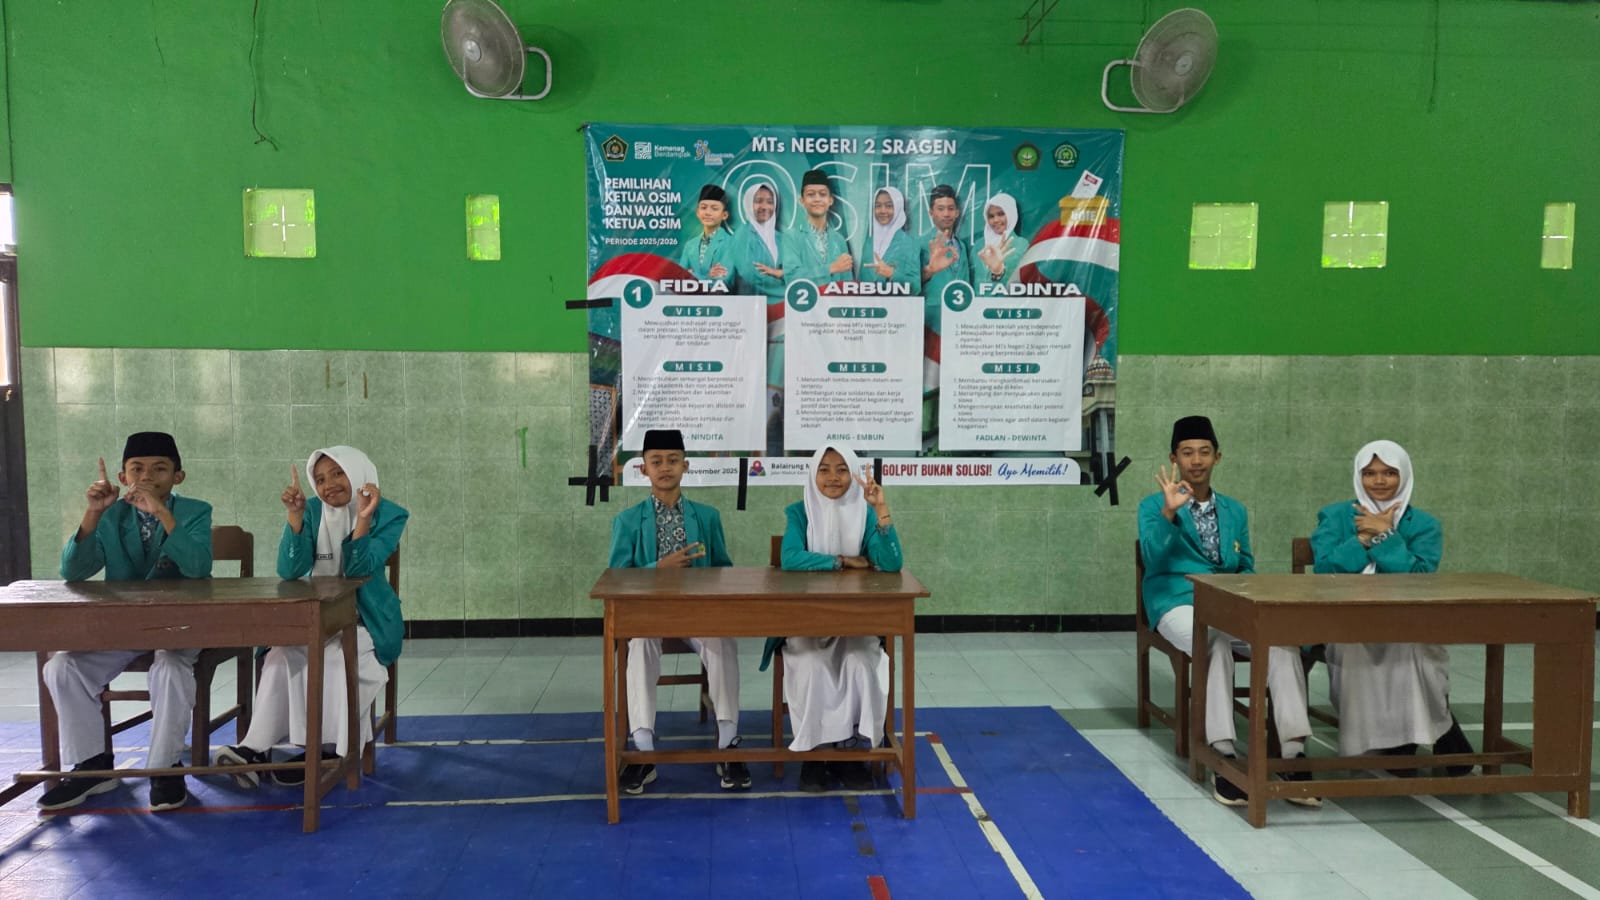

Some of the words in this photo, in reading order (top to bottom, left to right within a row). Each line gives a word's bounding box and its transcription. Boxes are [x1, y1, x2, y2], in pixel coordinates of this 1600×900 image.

[752, 137, 785, 153] MTs
[791, 137, 856, 154] NEGERI
[864, 139, 875, 154] 2
[882, 139, 957, 154] SRAGEN
[605, 178, 671, 190] PEMILIHAN
[605, 191, 646, 203] KETUA
[648, 191, 681, 203] OSIM
[605, 205, 632, 216] DAN
[634, 205, 675, 217] WAKIL
[605, 218, 646, 230] KETUA
[648, 218, 681, 230] OSIM
[605, 238, 638, 246] PERIODE
[639, 237, 678, 247] 2025/2026
[631, 286, 642, 301] 1
[659, 279, 729, 293] FIDTA
[796, 288, 810, 305] 2
[823, 281, 910, 294] ARBUN
[952, 290, 965, 305] 3
[979, 282, 1081, 296] FADINTA
[675, 307, 710, 316] VISI
[841, 308, 874, 317] VISI
[996, 309, 1031, 318] VISI
[675, 362, 711, 371] MISI
[839, 364, 875, 372] MISI
[994, 364, 1029, 373] MISI
[691, 433, 724, 441] NINDITA
[826, 433, 851, 441] ARING
[856, 433, 885, 441] EMBUN
[975, 434, 1006, 442] FADLAN
[1011, 434, 1047, 442] DEWINTA
[722, 467, 738, 475] 2025
[771, 463, 805, 471] Balairung
[882, 463, 919, 477] GOLPUT
[921, 463, 953, 477] BUKAN
[956, 463, 992, 477] SOLUSI!
[998, 463, 1017, 480] Ayo
[1020, 463, 1069, 478] Memilih!
